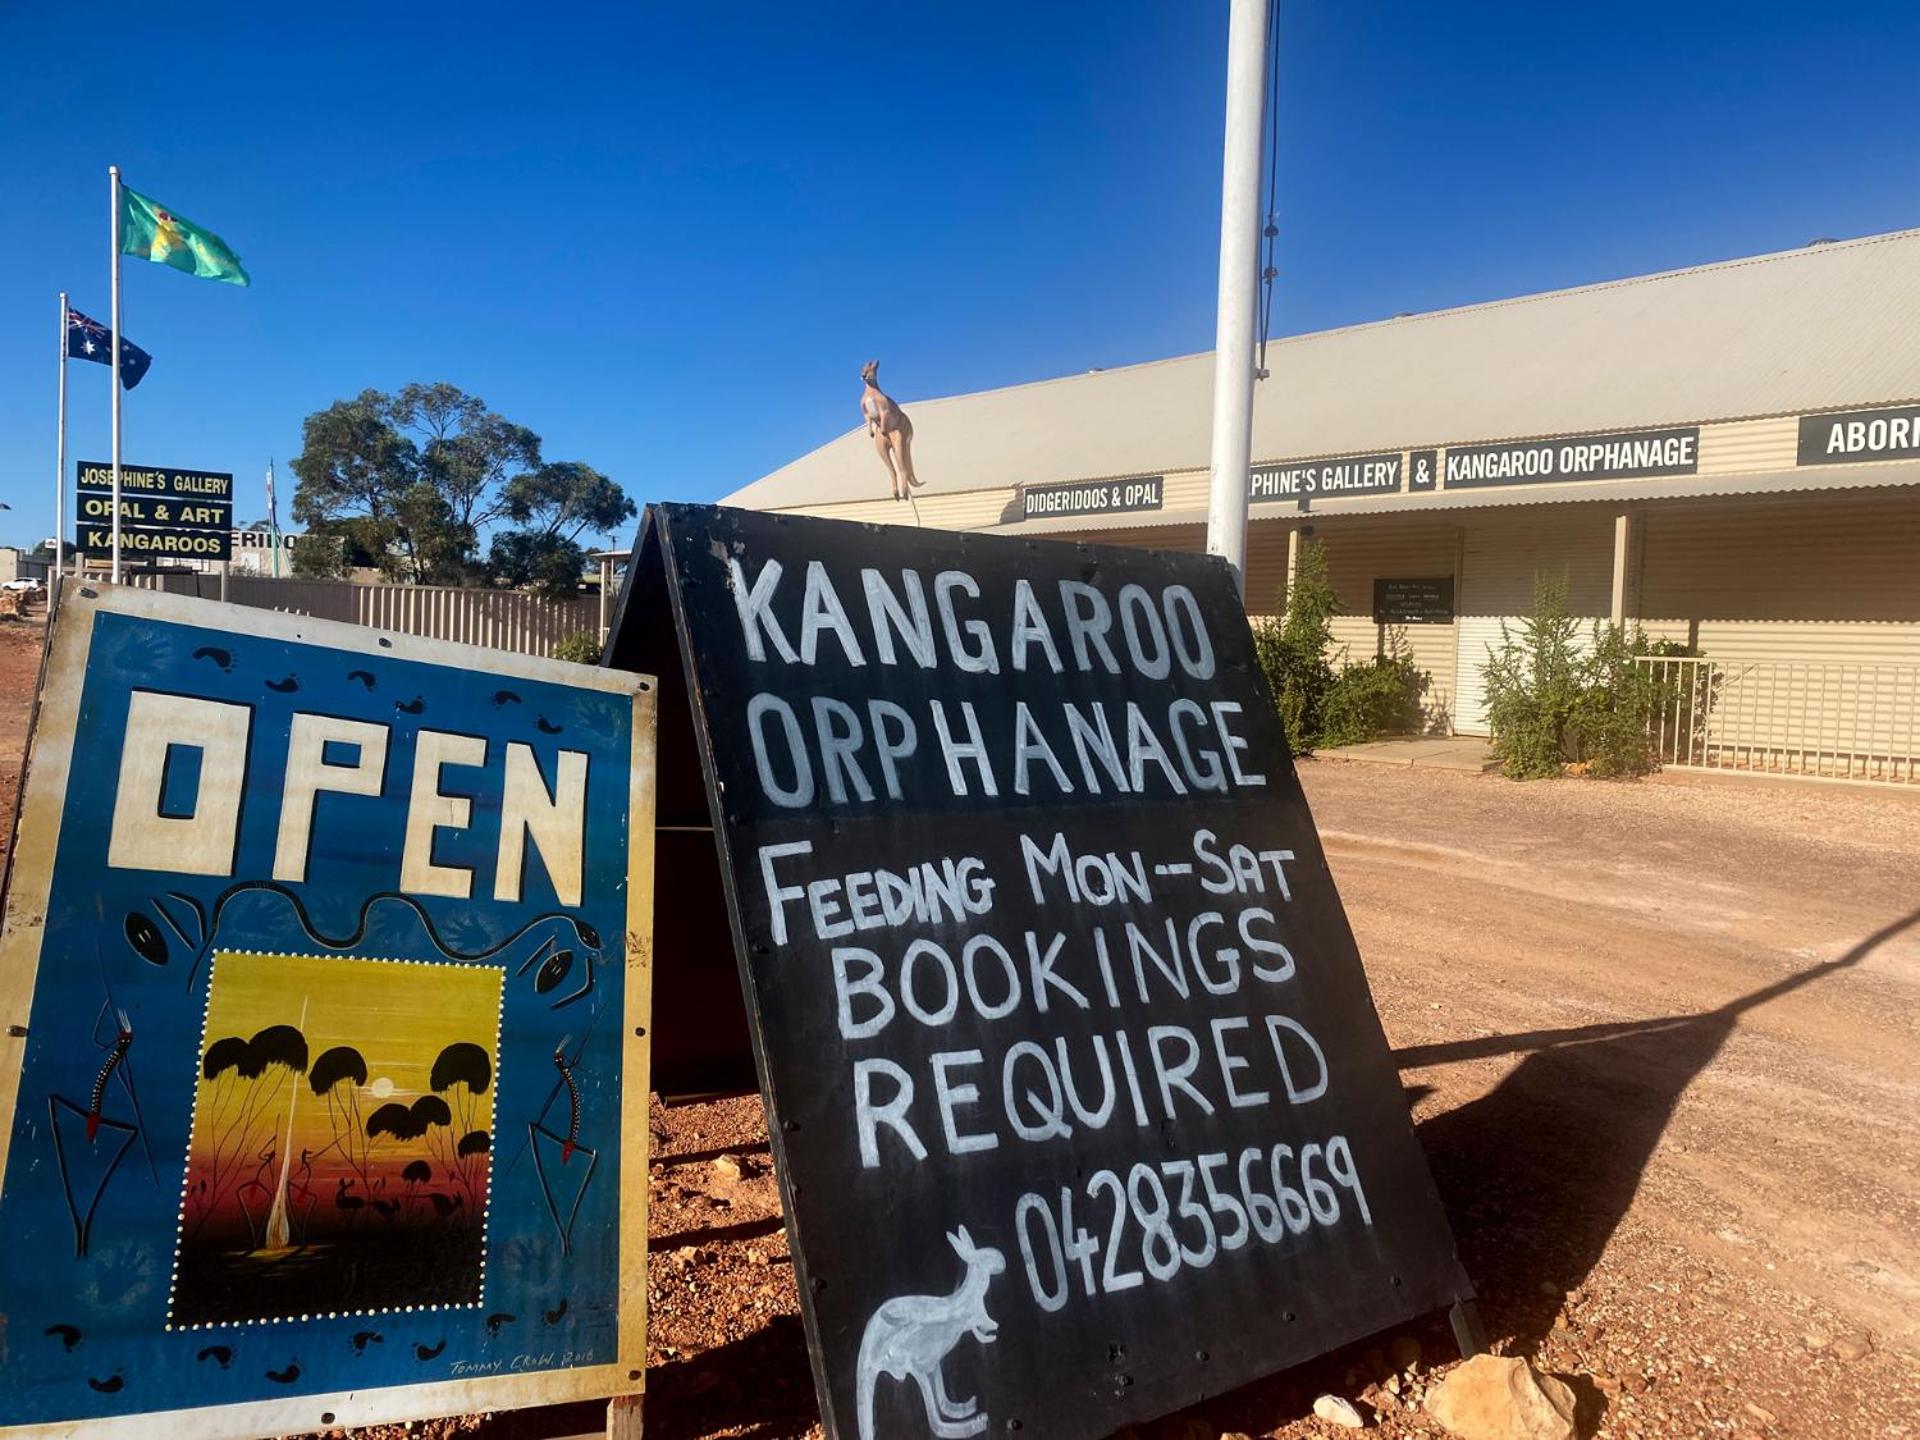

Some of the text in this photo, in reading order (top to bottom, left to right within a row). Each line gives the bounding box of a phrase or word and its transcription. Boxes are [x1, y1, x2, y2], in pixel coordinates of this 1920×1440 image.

[1826, 414, 1920, 454] ABORI
[1249, 461, 1398, 496] PHINE'S GALLERY
[1415, 459, 1430, 484] &
[1447, 436, 1694, 482] KANGAROO ORPHANAGE
[174, 475, 229, 494] GALLERY
[1026, 483, 1159, 514] DIDGERIDOOS & OPAL
[154, 504, 169, 521] &
[180, 506, 224, 524] ART
[88, 531, 221, 554] KANGAROOS
[730, 558, 1215, 681] KANGAROO
[747, 692, 1266, 807] ORPHANAGE
[107, 690, 588, 907] OPEN
[758, 840, 996, 945] FEEDING
[831, 907, 1296, 1040] BOOKINGS
[853, 1014, 1328, 1168] REQUIRED
[1015, 1135, 1372, 1311] 0428356669
